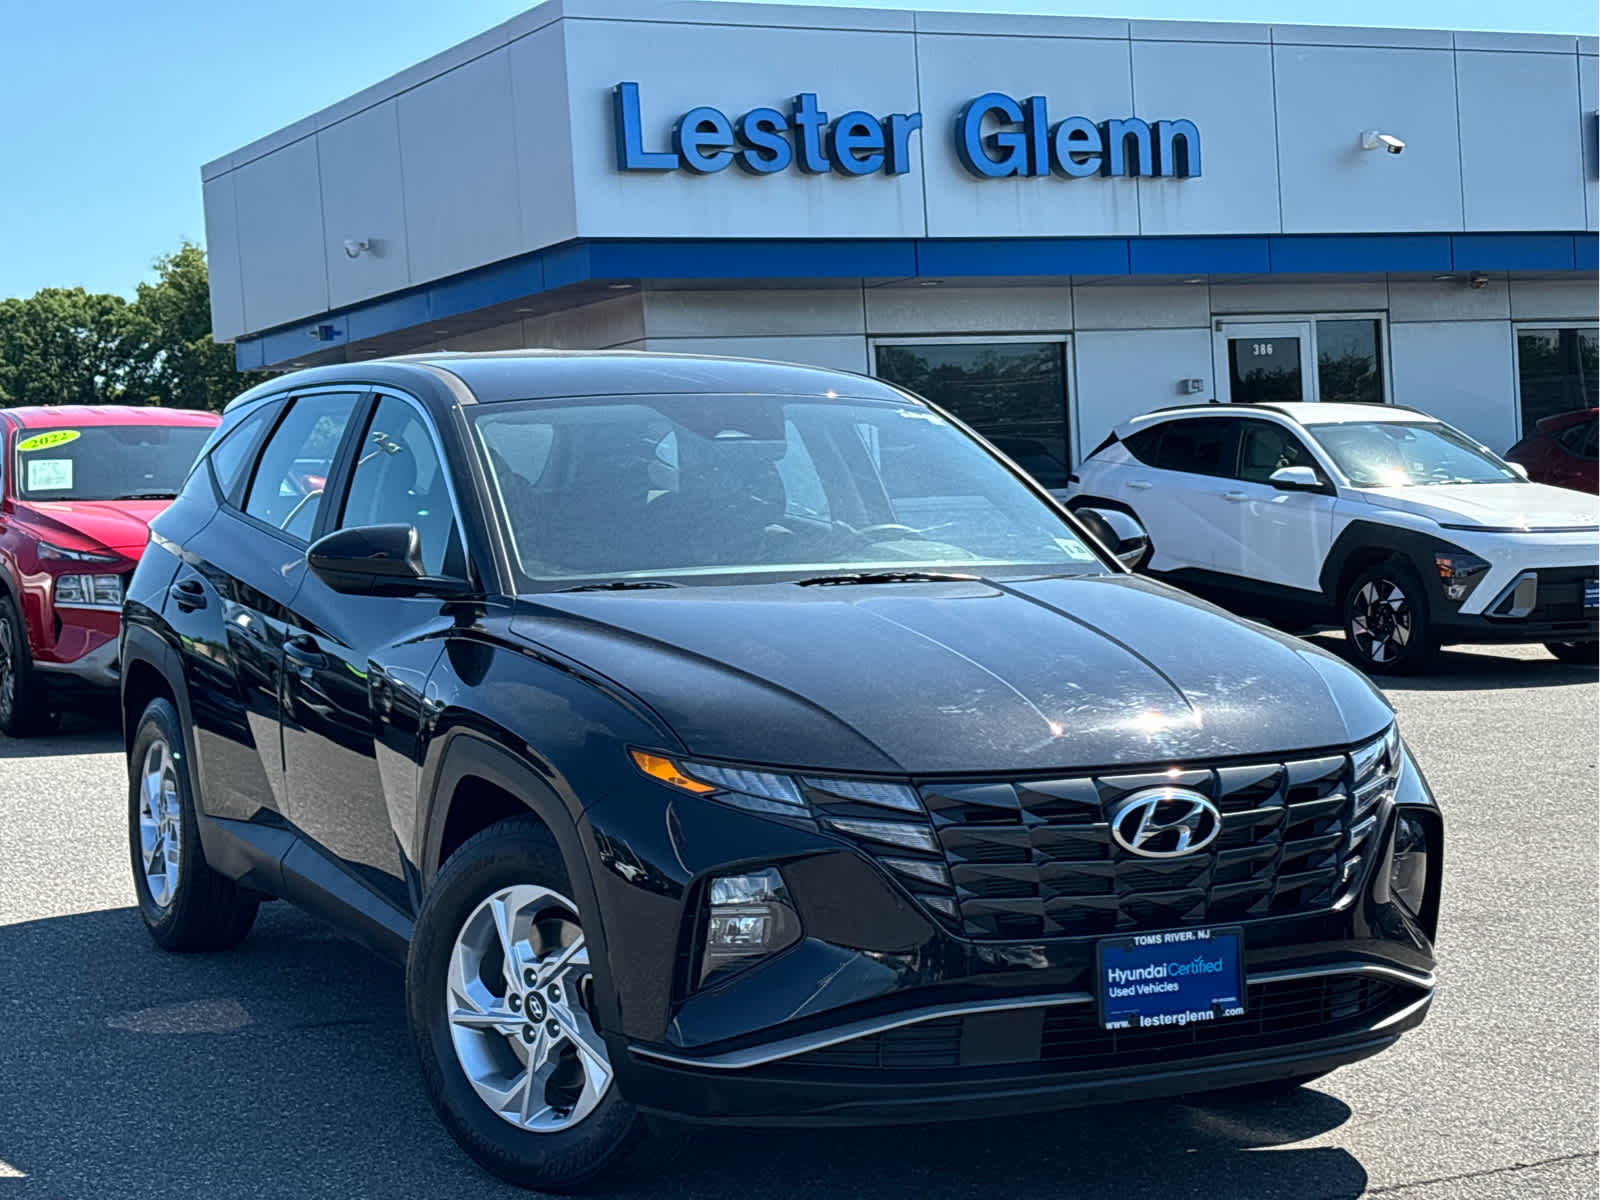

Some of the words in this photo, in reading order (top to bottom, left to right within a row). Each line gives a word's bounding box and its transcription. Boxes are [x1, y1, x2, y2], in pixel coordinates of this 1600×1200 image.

[612, 82, 922, 175] Lester
[955, 92, 1202, 179] Glenn
[1253, 343, 1273, 355] 386
[31, 432, 69, 448] 2022
[1133, 936, 1162, 946] TOMS
[1198, 930, 1210, 939] NJ
[1109, 985, 1135, 998] Used
[1137, 981, 1179, 995] Vehicles
[1140, 1010, 1214, 1027] lesterglenn
